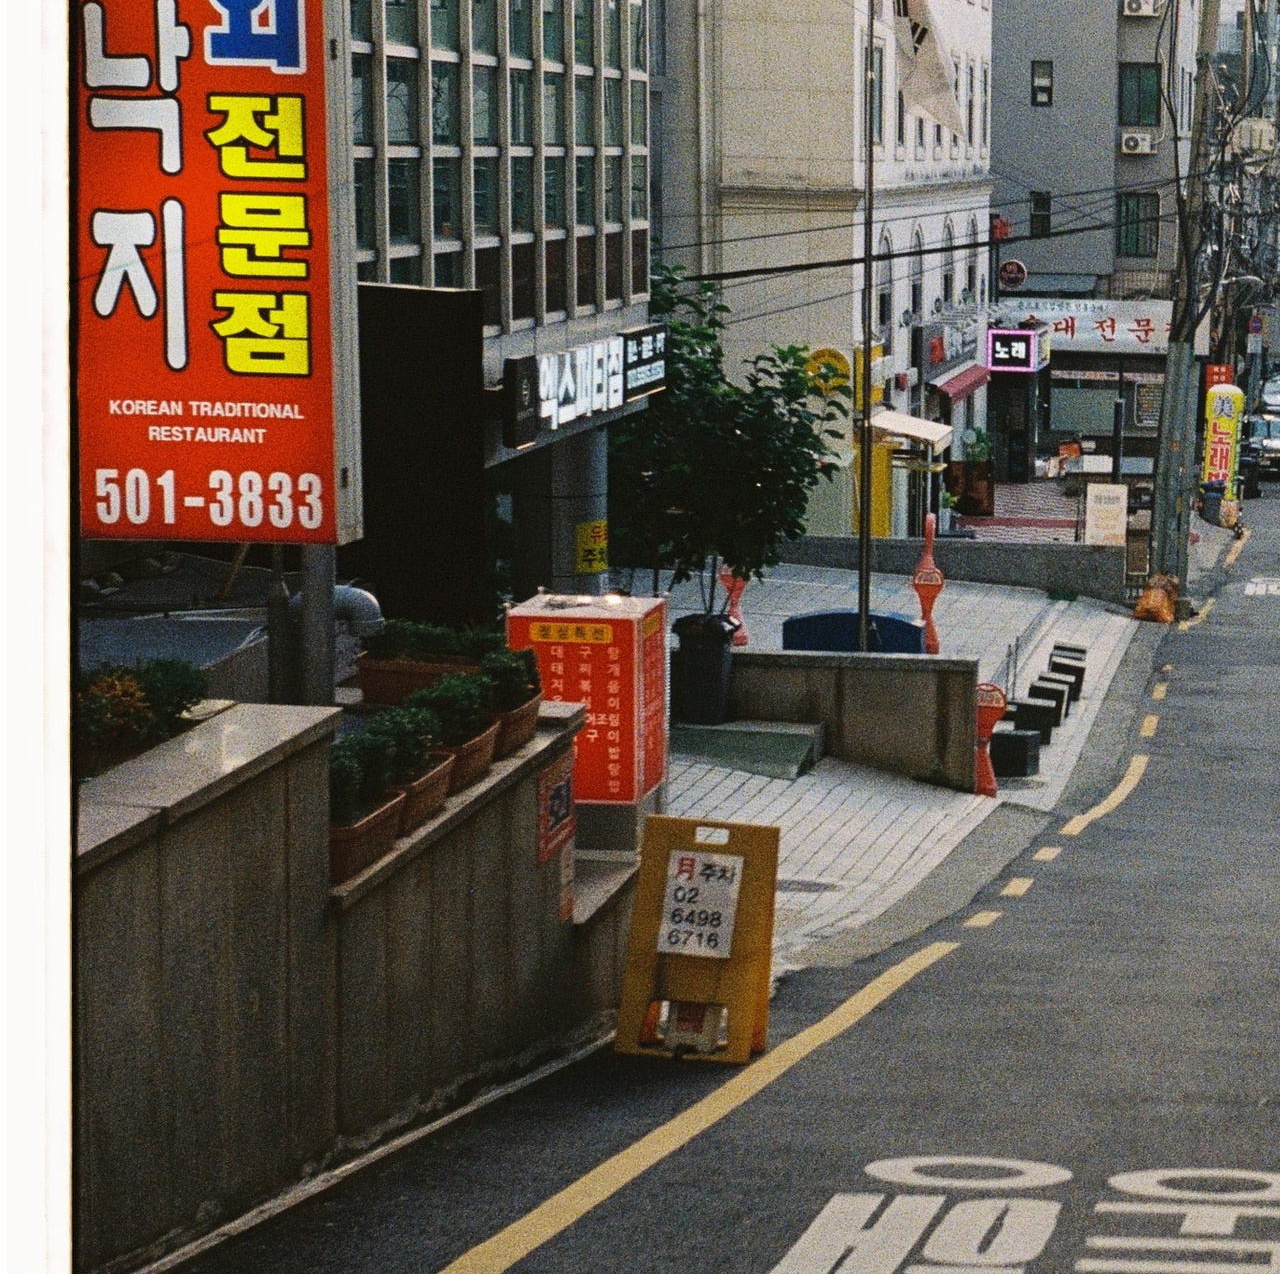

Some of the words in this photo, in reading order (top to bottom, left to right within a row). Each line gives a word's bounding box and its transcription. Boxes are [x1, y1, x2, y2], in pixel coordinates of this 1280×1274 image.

[206, 91, 313, 378] 전문점
[994, 340, 1027, 360] 노래
[108, 399, 184, 417] KOREAN
[189, 400, 306, 421] TRADITIONAL
[1212, 395, 1236, 419] 美
[147, 425, 268, 445] RESTAURANT
[93, 466, 325, 531] 501-3833
[550, 662, 621, 678] 태찌개
[673, 886, 699, 905] 02
[670, 907, 722, 928] 6498
[667, 928, 719, 949] 6716
